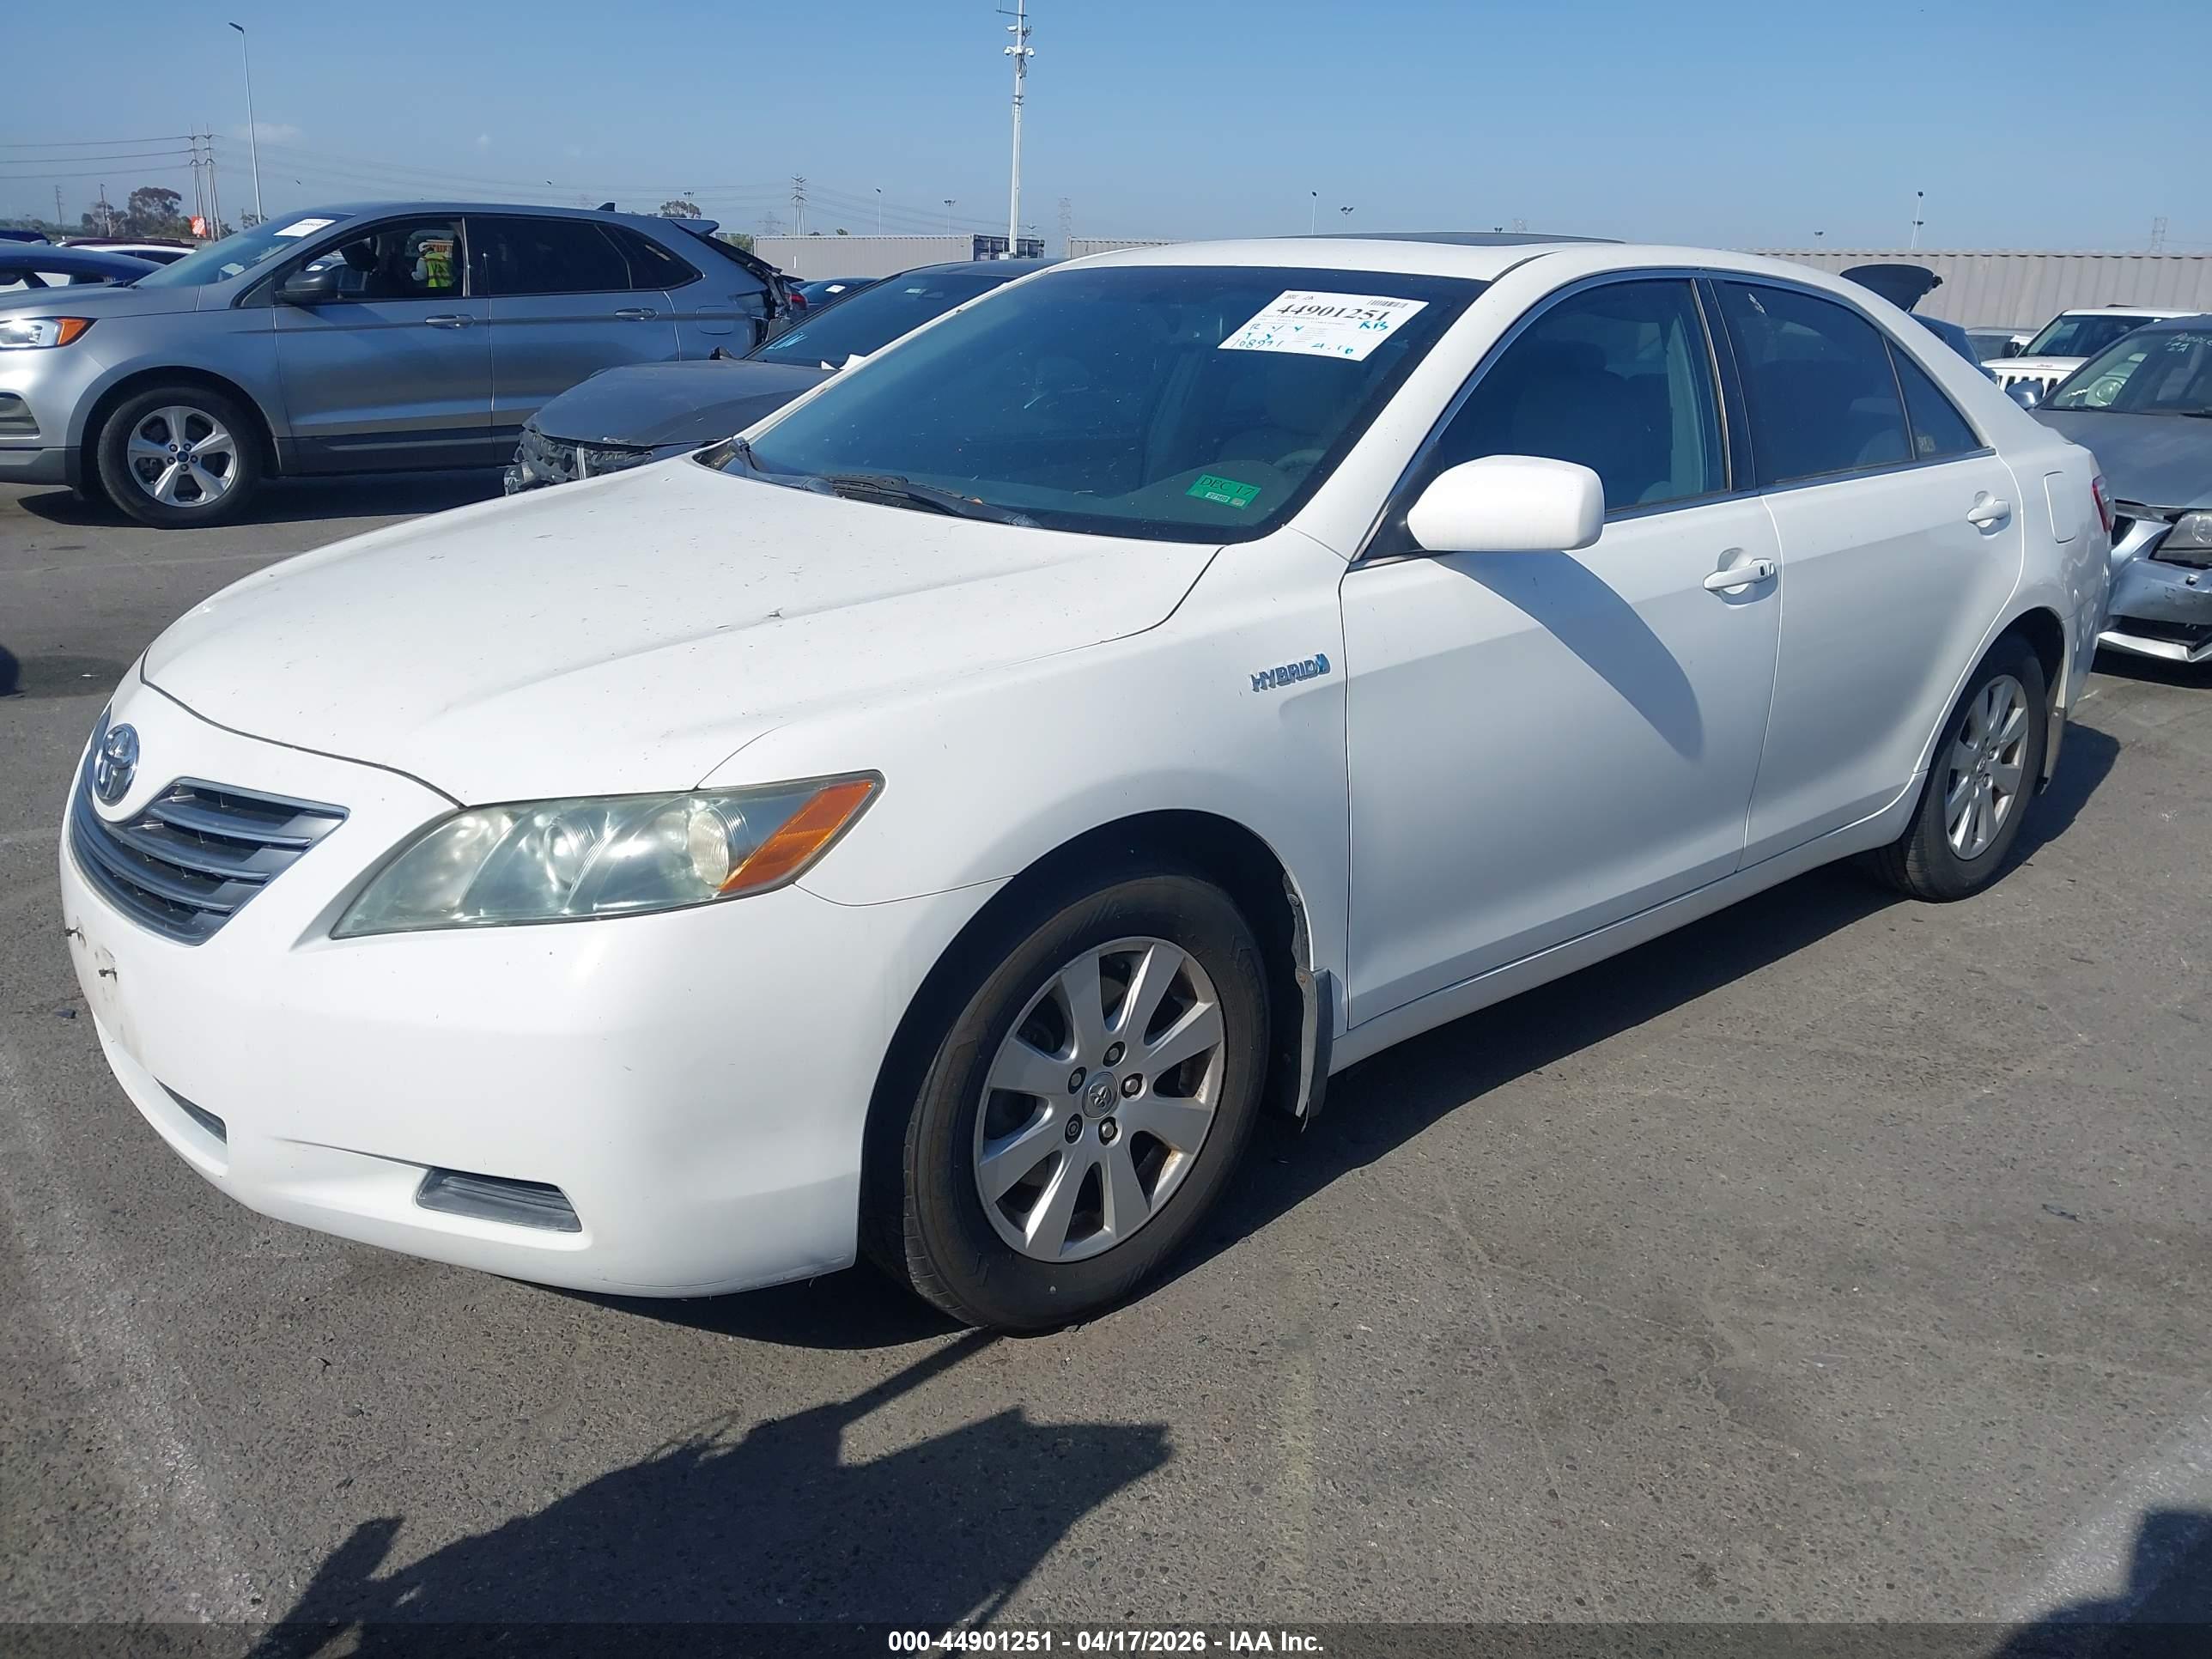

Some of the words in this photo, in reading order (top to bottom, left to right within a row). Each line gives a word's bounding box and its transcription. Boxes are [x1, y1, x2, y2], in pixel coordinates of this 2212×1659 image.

[1277, 303, 1391, 322] 44901251
[1200, 477, 1231, 491] DEC
[1236, 485, 1255, 495] 17
[1250, 659, 1319, 693] HYBRID
